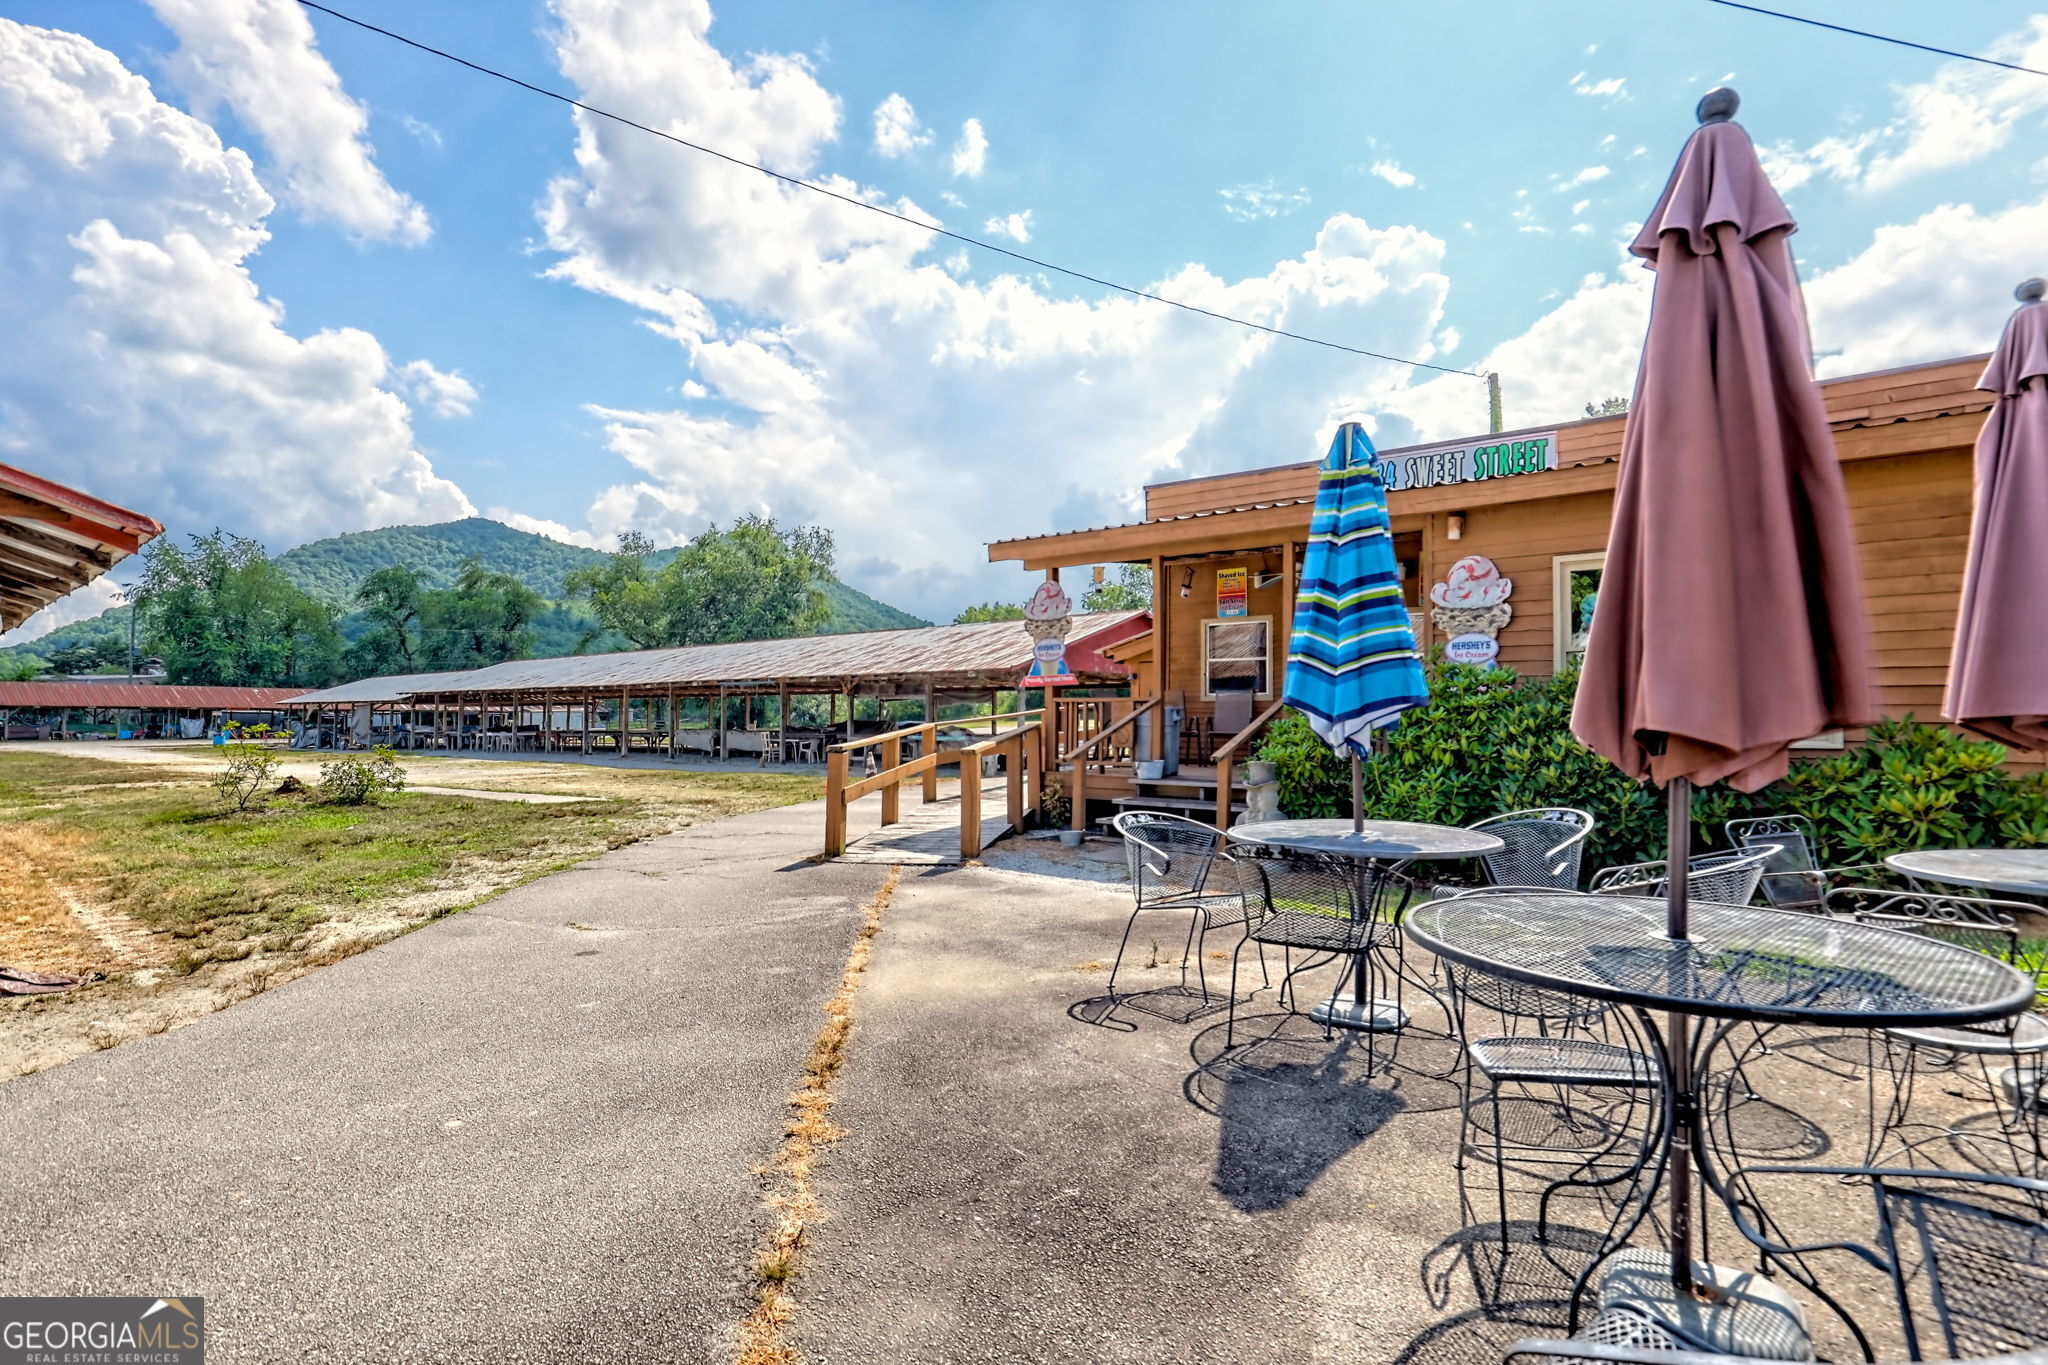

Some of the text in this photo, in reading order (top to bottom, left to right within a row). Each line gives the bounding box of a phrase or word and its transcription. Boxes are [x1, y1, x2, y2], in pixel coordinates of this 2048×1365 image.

[1405, 450, 1465, 488] SWEET
[1474, 438, 1548, 479] STREET
[1451, 640, 1491, 650] HERSHEY'S
